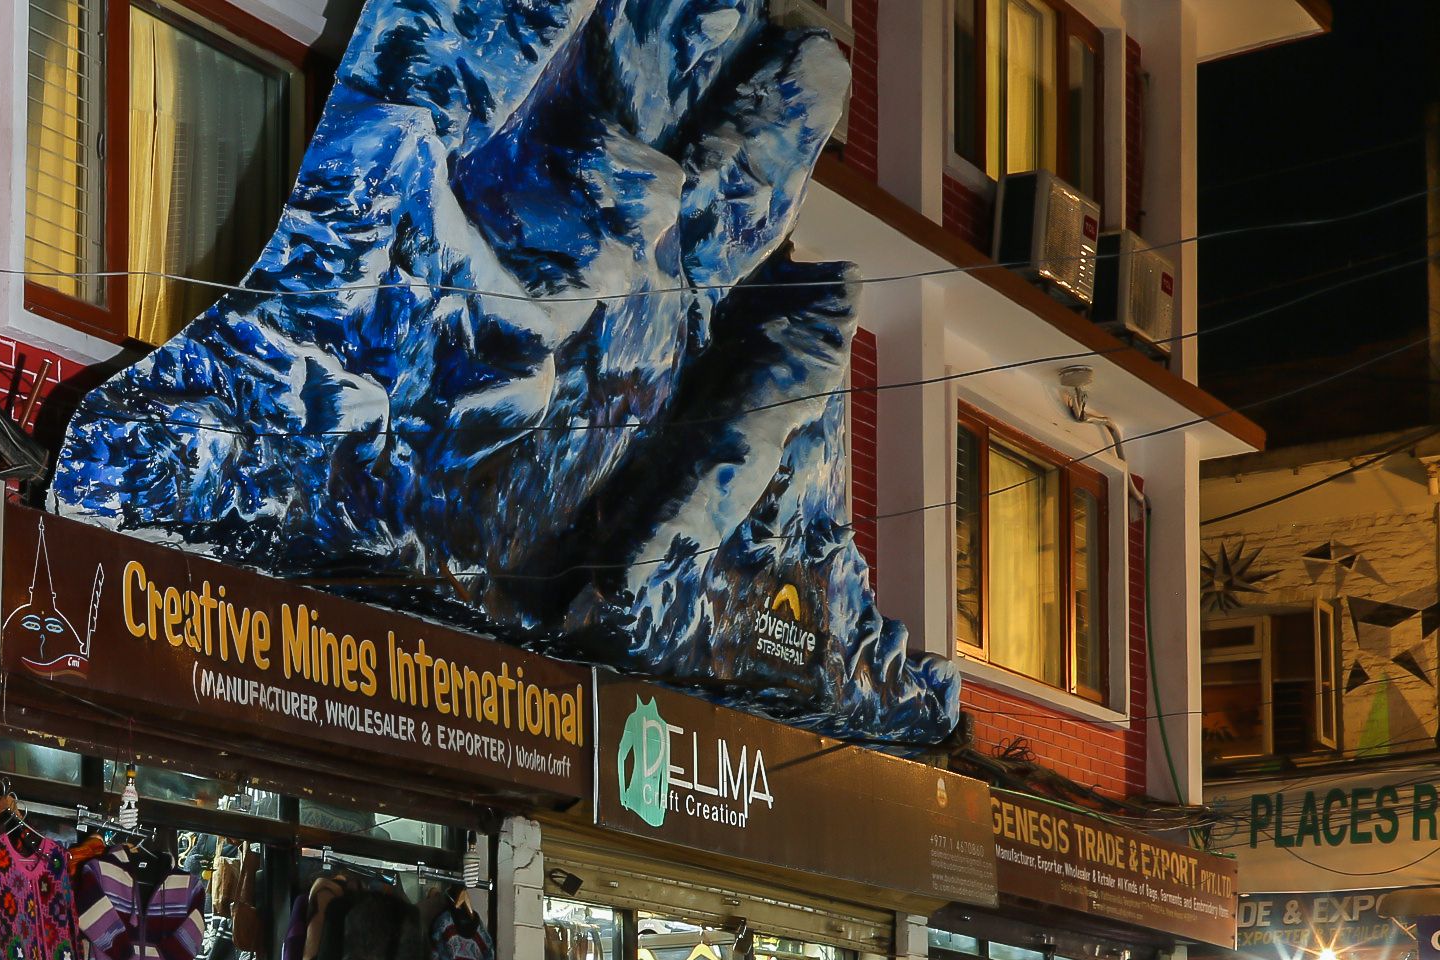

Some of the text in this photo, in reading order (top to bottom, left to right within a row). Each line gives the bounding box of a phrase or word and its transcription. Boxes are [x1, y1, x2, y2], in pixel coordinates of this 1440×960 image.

[122, 560, 583, 747] Creative Mines International
[326, 700, 417, 742] WHOLESALER
[421, 721, 432, 746] &
[437, 725, 512, 768] EXPORTER)
[516, 745, 546, 772] Woolen
[643, 783, 746, 828] Craft Creation
[1250, 784, 1400, 848] PLACES
[990, 797, 1070, 854] GENESIS
[1073, 823, 1125, 869] TRADE
[1129, 839, 1138, 872] &
[1141, 842, 1198, 889] EXPORT
[1283, 899, 1302, 925] &
